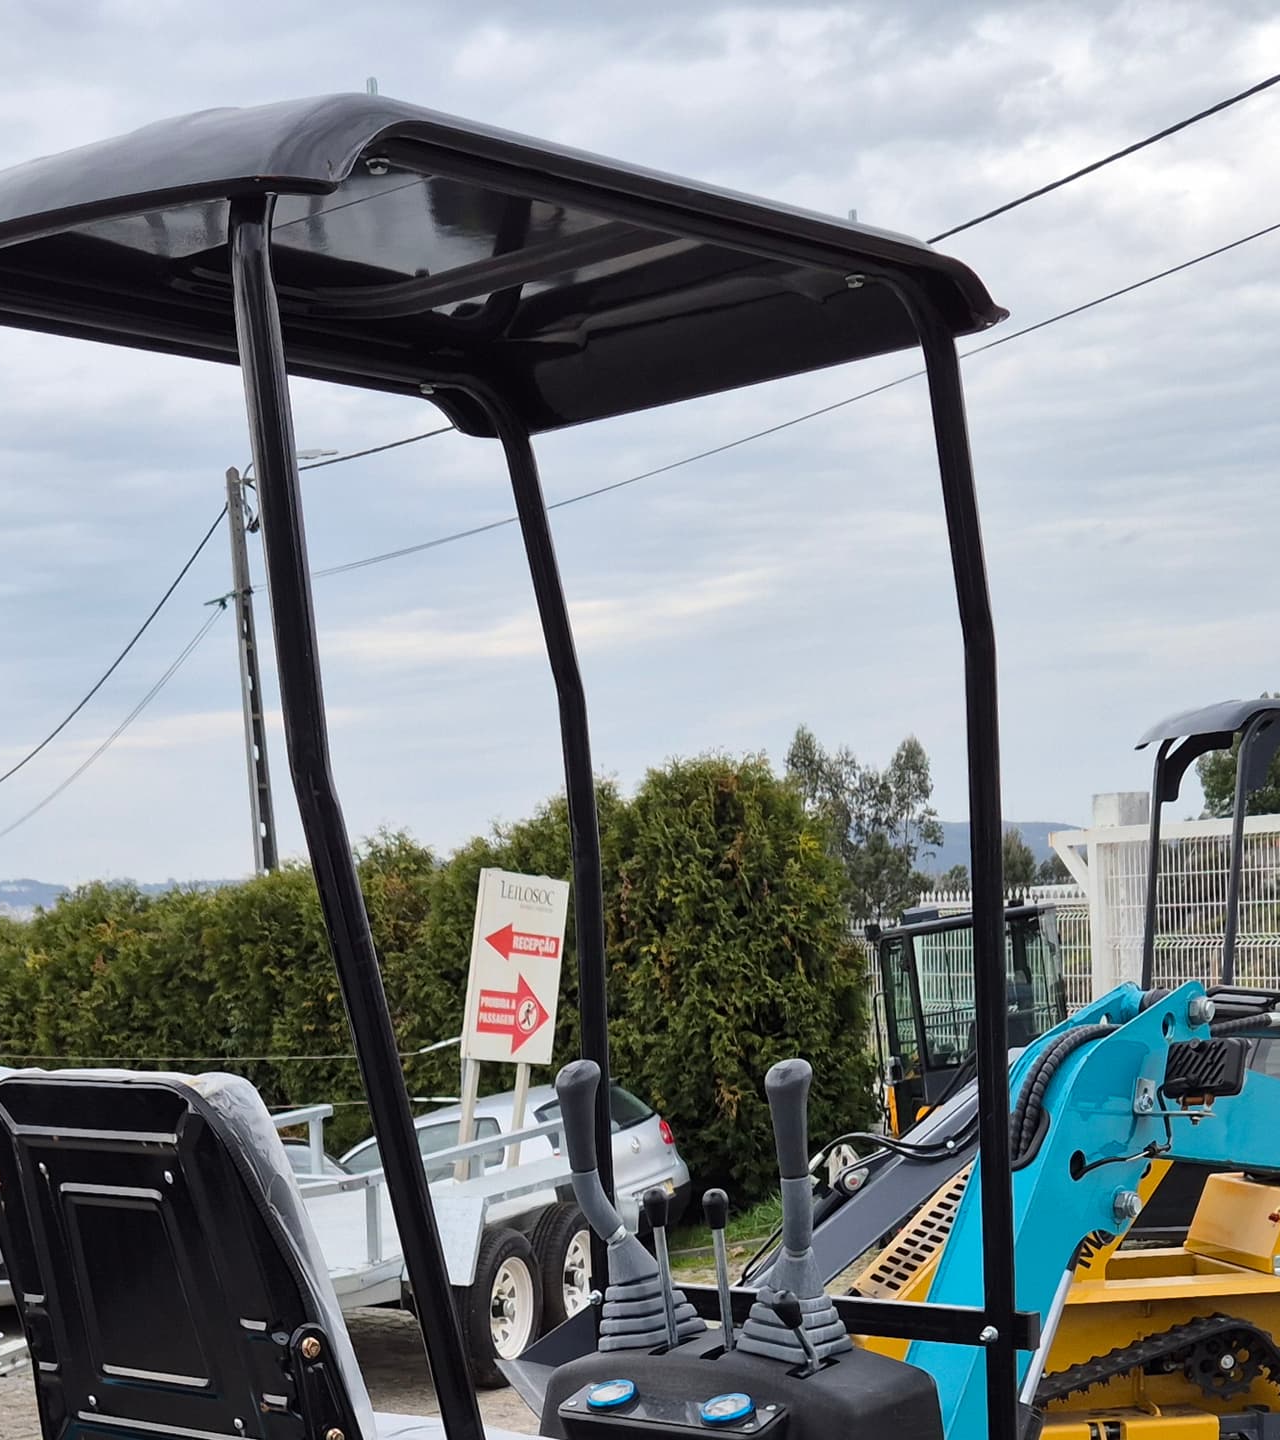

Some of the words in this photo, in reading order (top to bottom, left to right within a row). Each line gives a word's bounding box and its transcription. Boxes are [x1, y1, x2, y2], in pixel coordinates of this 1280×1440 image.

[500, 880, 555, 906] LEILOSOC
[512, 935, 556, 956] RECEPÇÃO
[479, 1012, 515, 1026] PASSAGEM
